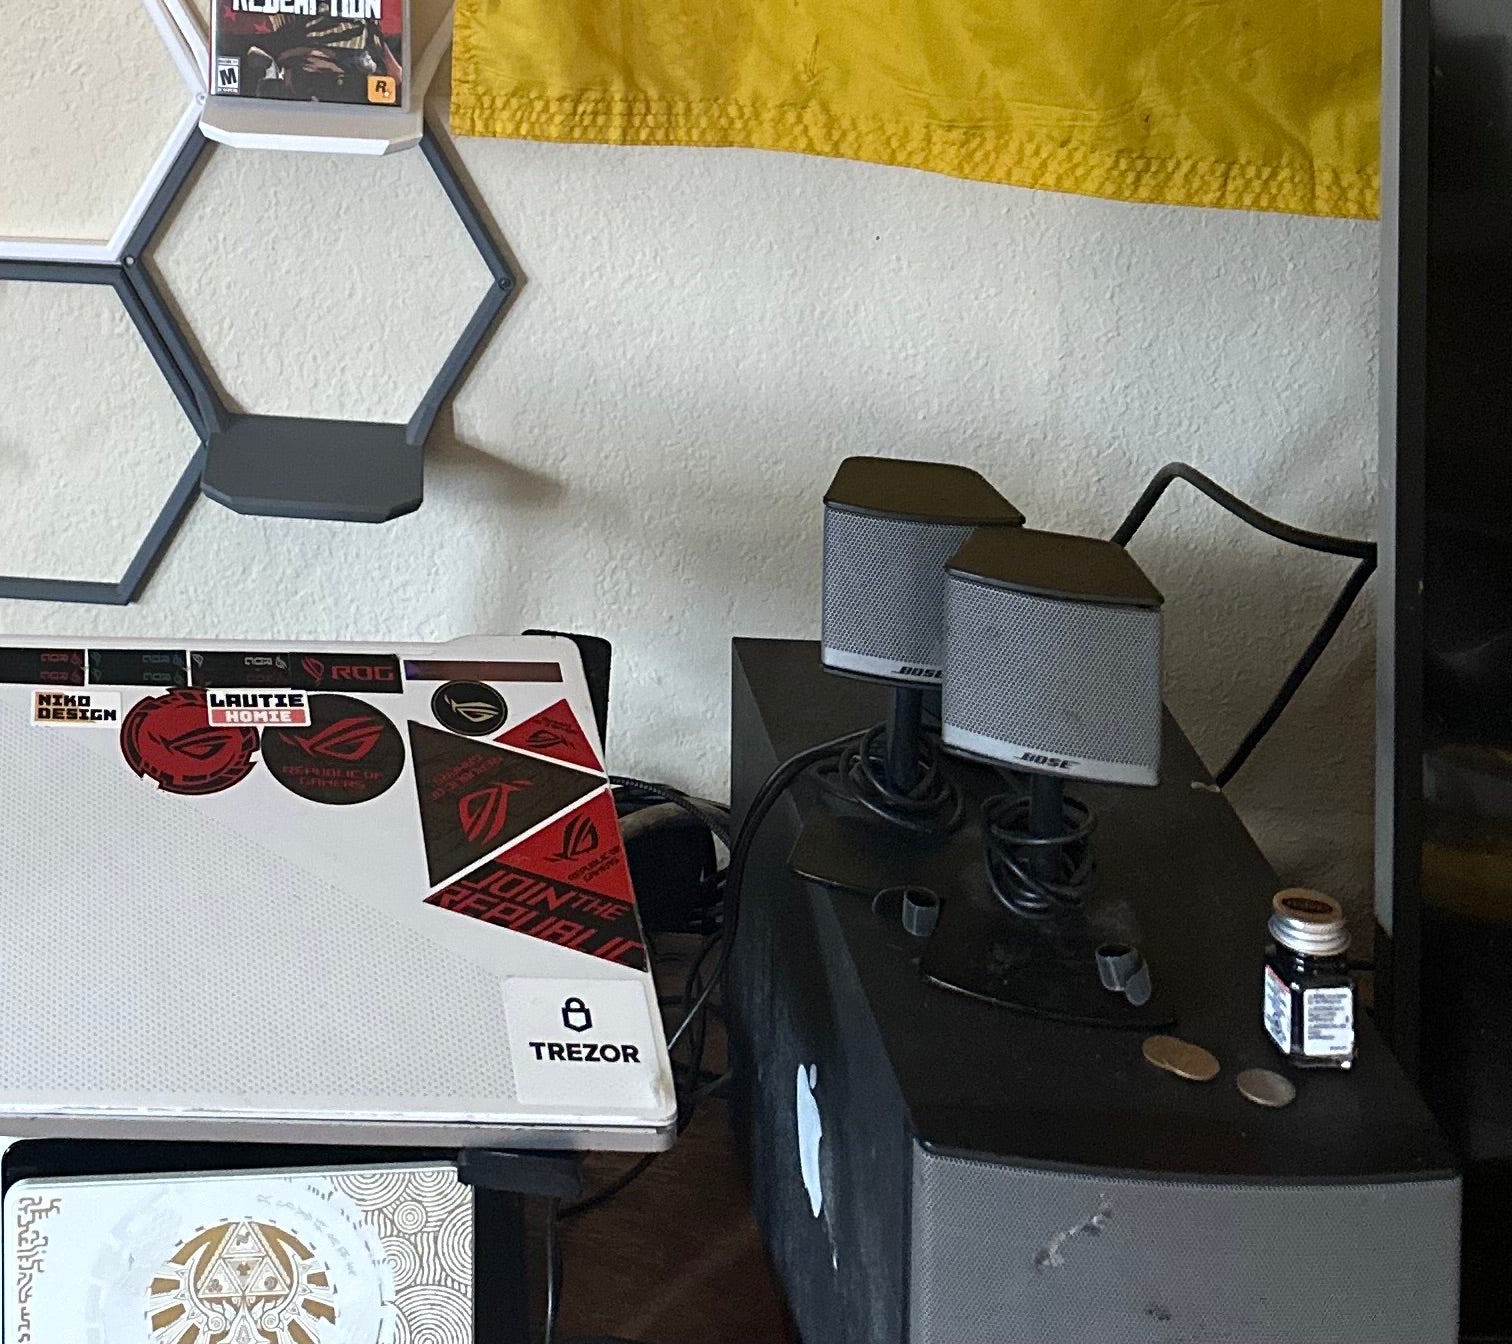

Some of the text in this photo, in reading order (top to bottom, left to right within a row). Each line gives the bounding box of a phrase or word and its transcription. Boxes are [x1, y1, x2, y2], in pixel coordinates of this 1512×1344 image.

[331, 665, 393, 680] ROG
[38, 694, 91, 707] NIKO
[210, 693, 304, 708] LAUTIE
[38, 708, 116, 721] DESIGN
[226, 710, 292, 723] HOMIE
[1014, 752, 1080, 769] BOSE
[282, 766, 384, 780] REPUBLIC OF
[299, 778, 366, 789] GAMERS
[455, 870, 632, 921] JOIN THE
[529, 1042, 640, 1063] TREZOR
